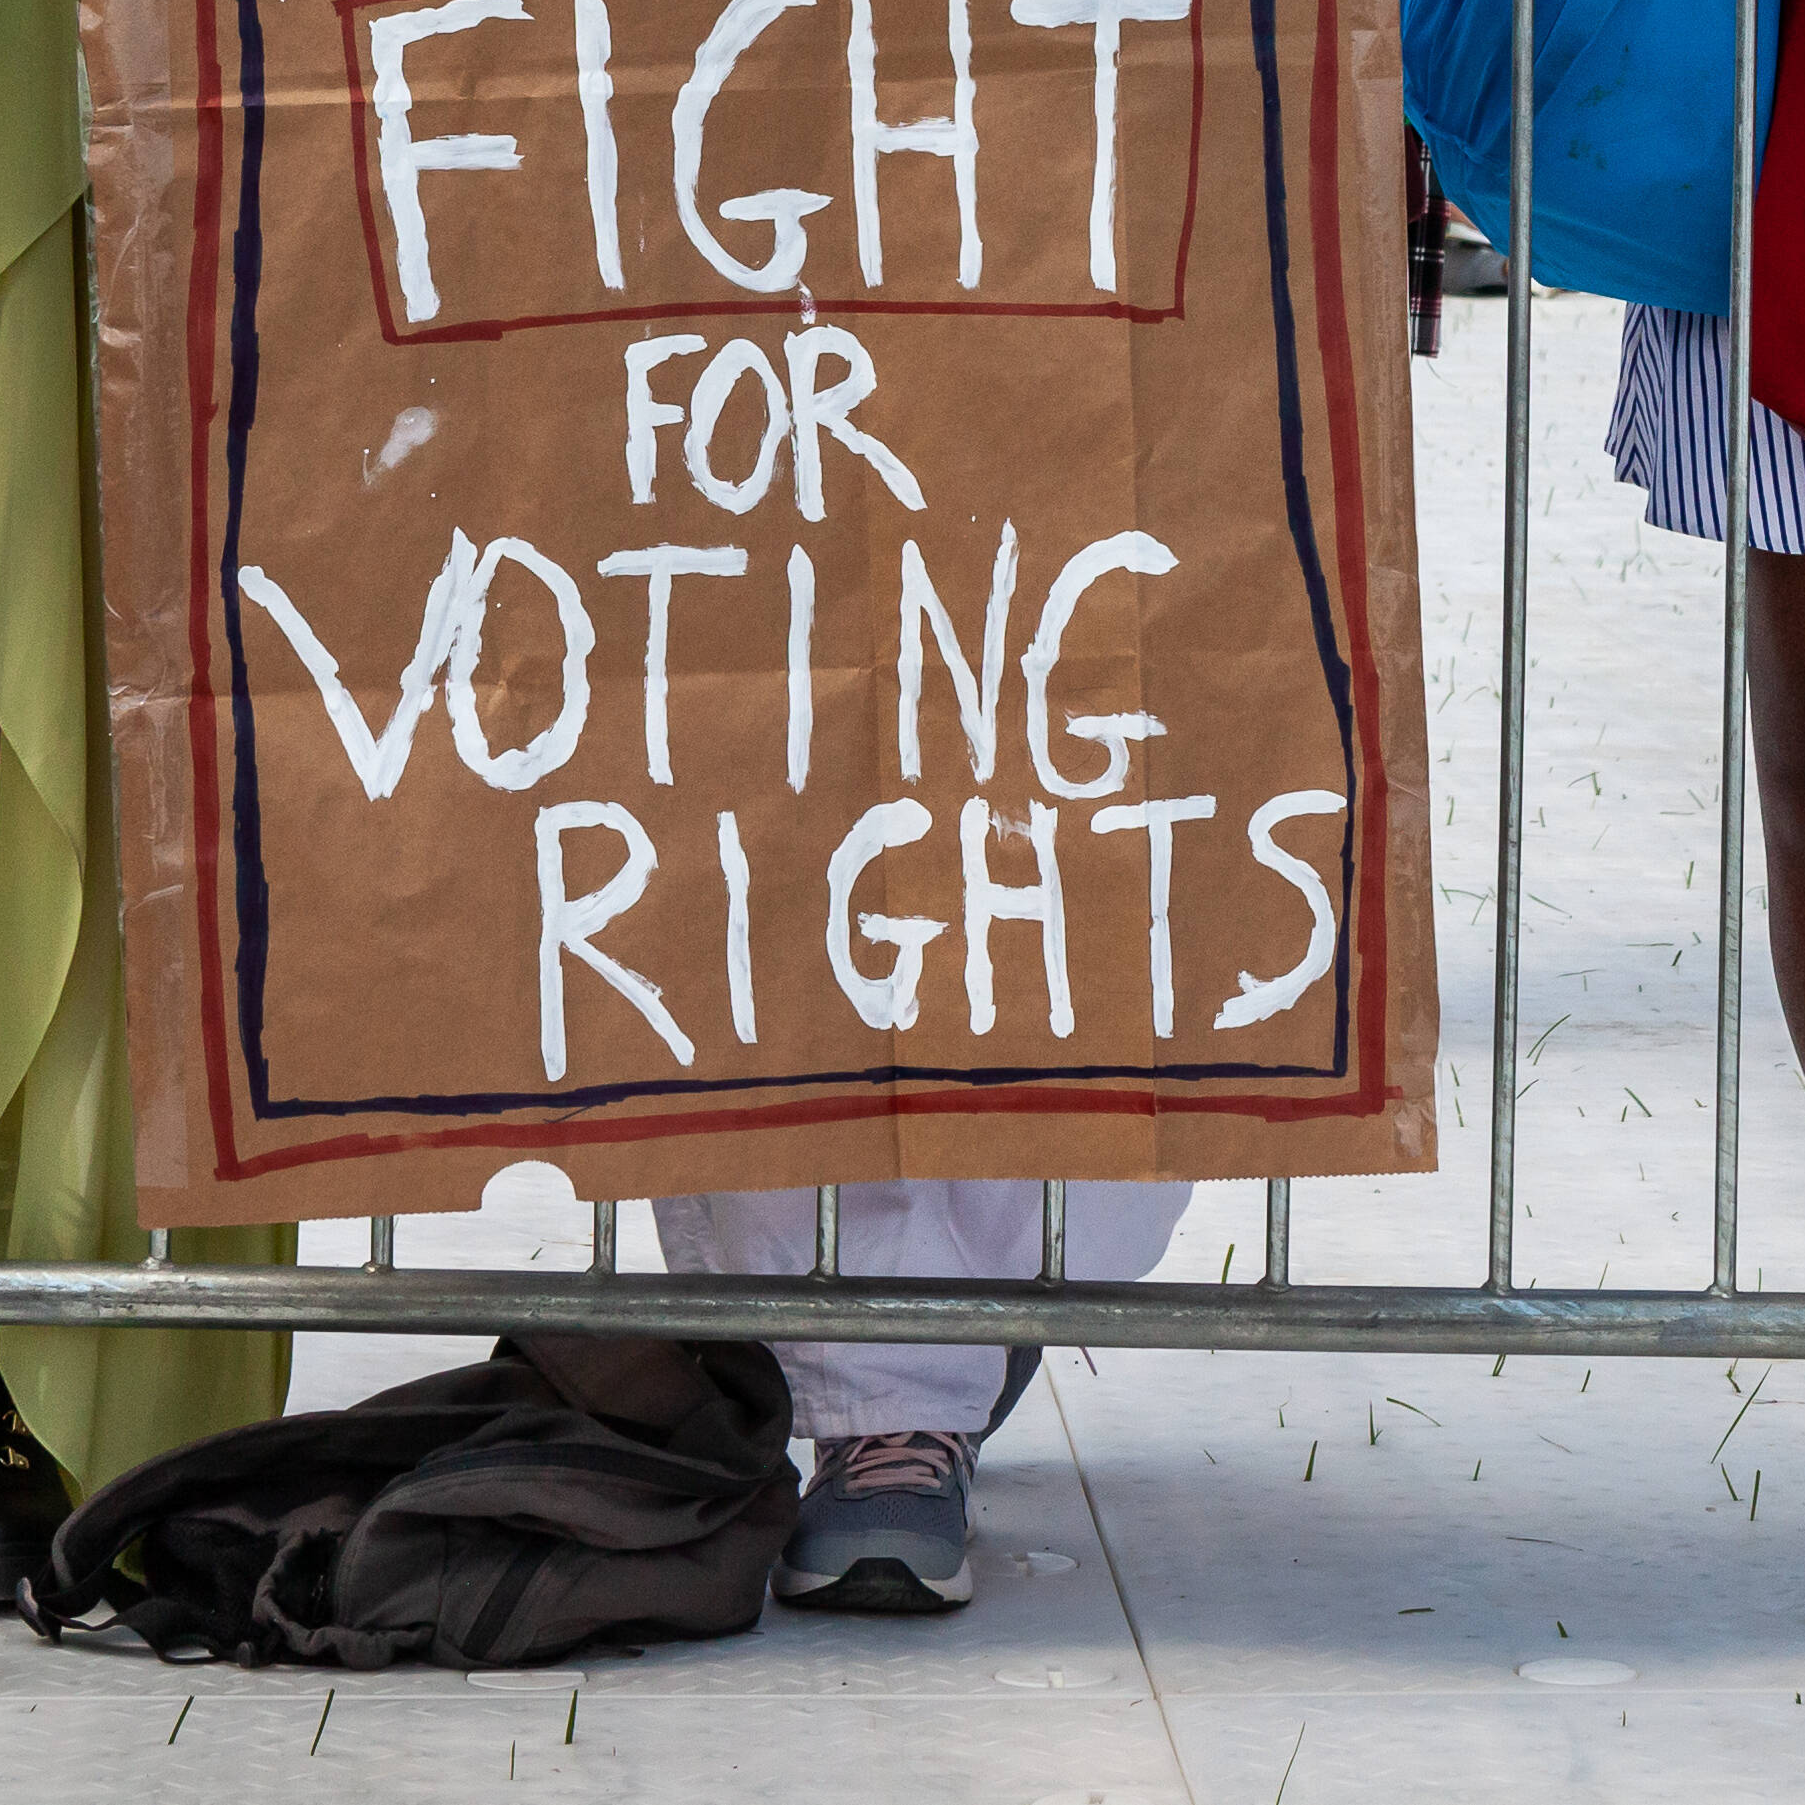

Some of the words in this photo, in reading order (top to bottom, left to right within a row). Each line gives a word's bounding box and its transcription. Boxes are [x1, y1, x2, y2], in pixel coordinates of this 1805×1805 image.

[623, 330, 927, 523] FOR
[236, 518, 1180, 804] VOTING
[533, 787, 1349, 1083] RIGHTS
